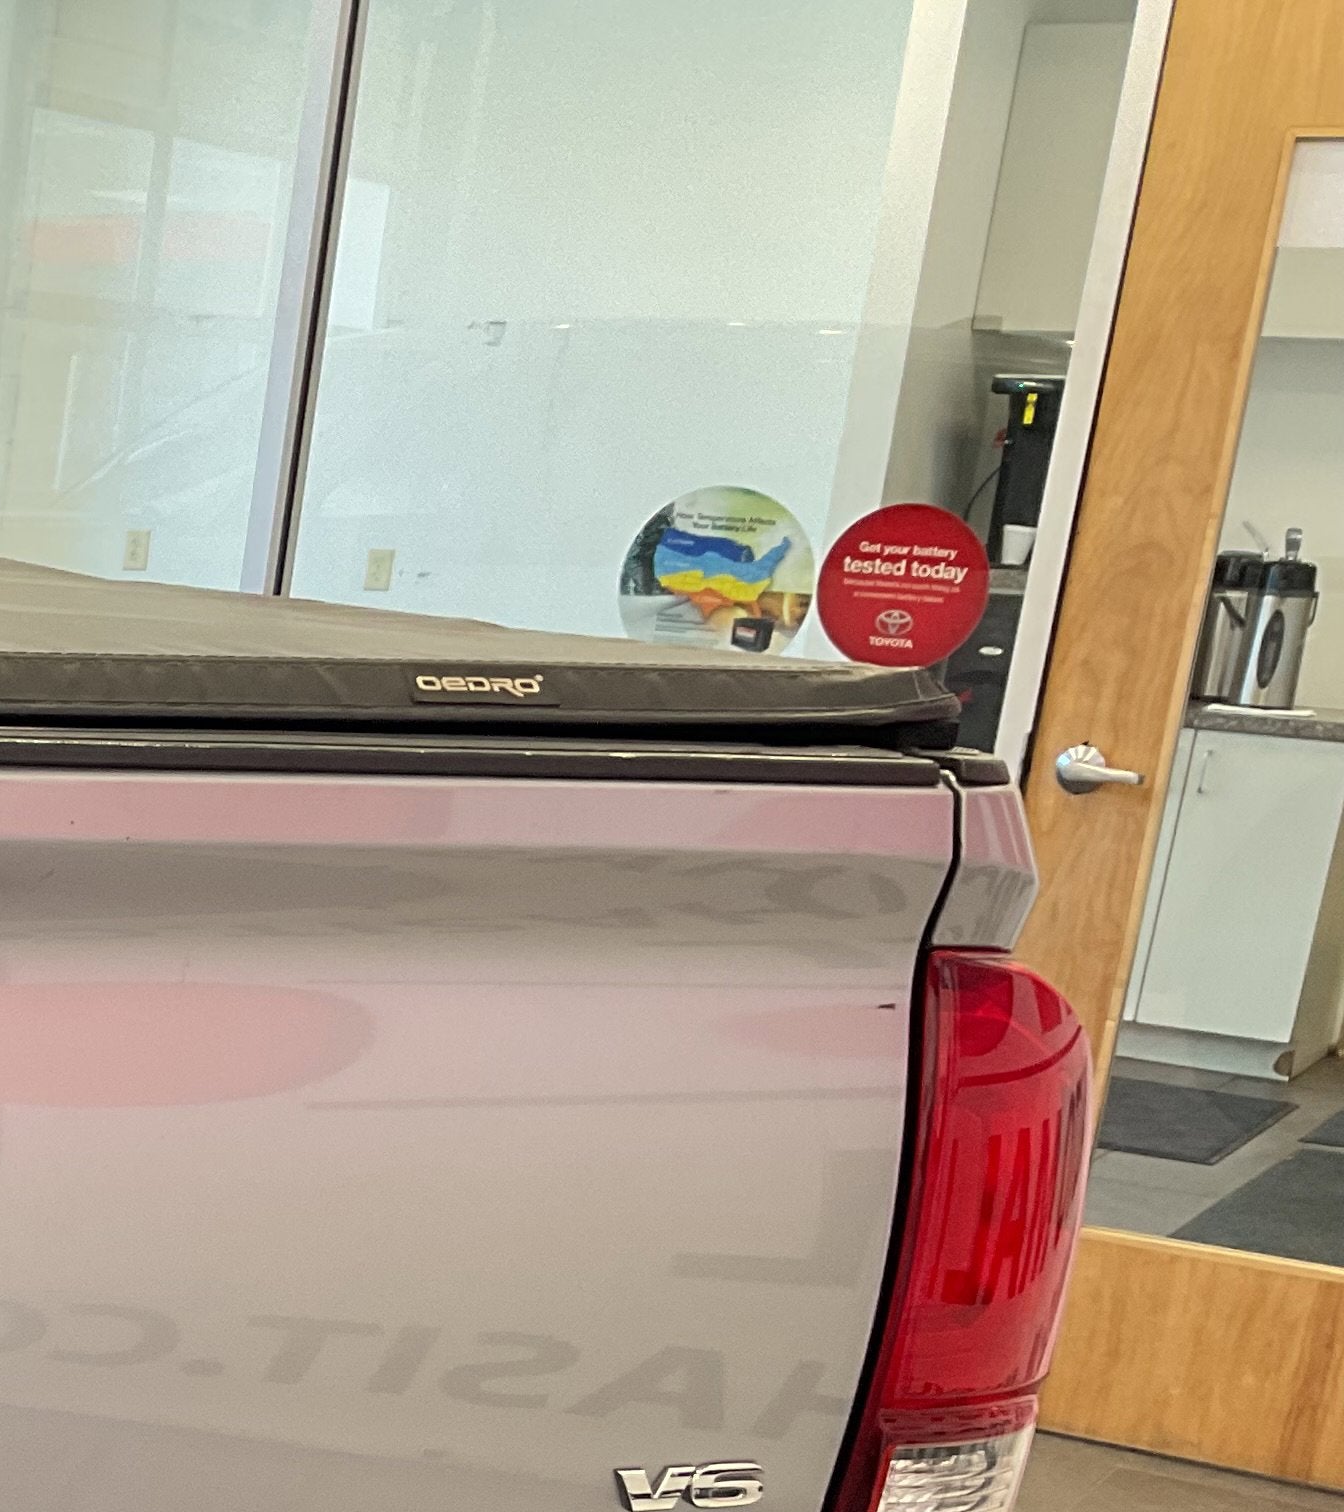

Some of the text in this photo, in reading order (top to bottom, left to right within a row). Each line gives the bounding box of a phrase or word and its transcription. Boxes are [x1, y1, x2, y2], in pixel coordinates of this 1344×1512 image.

[859, 541, 958, 560] Get your battery
[843, 556, 968, 584] tested today
[869, 636, 913, 648] TOYOTA
[614, 1460, 765, 1512] V6
